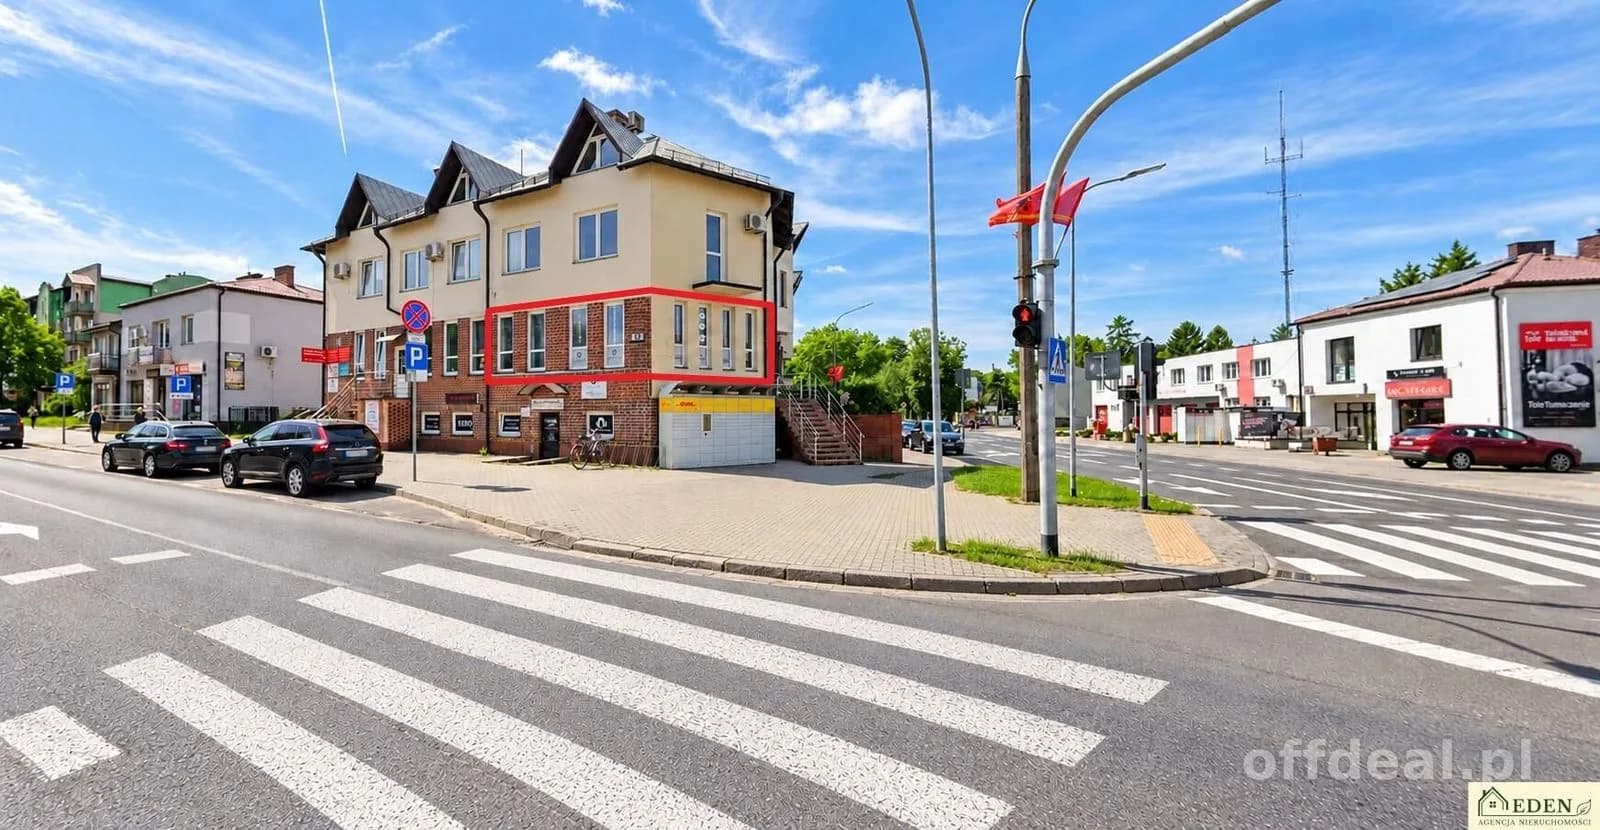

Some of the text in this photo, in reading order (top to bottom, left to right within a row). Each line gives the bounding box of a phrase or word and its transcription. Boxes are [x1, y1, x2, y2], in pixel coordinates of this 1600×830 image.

[411, 347, 423, 368] P
[60, 375, 70, 387] P
[176, 378, 186, 391] P
